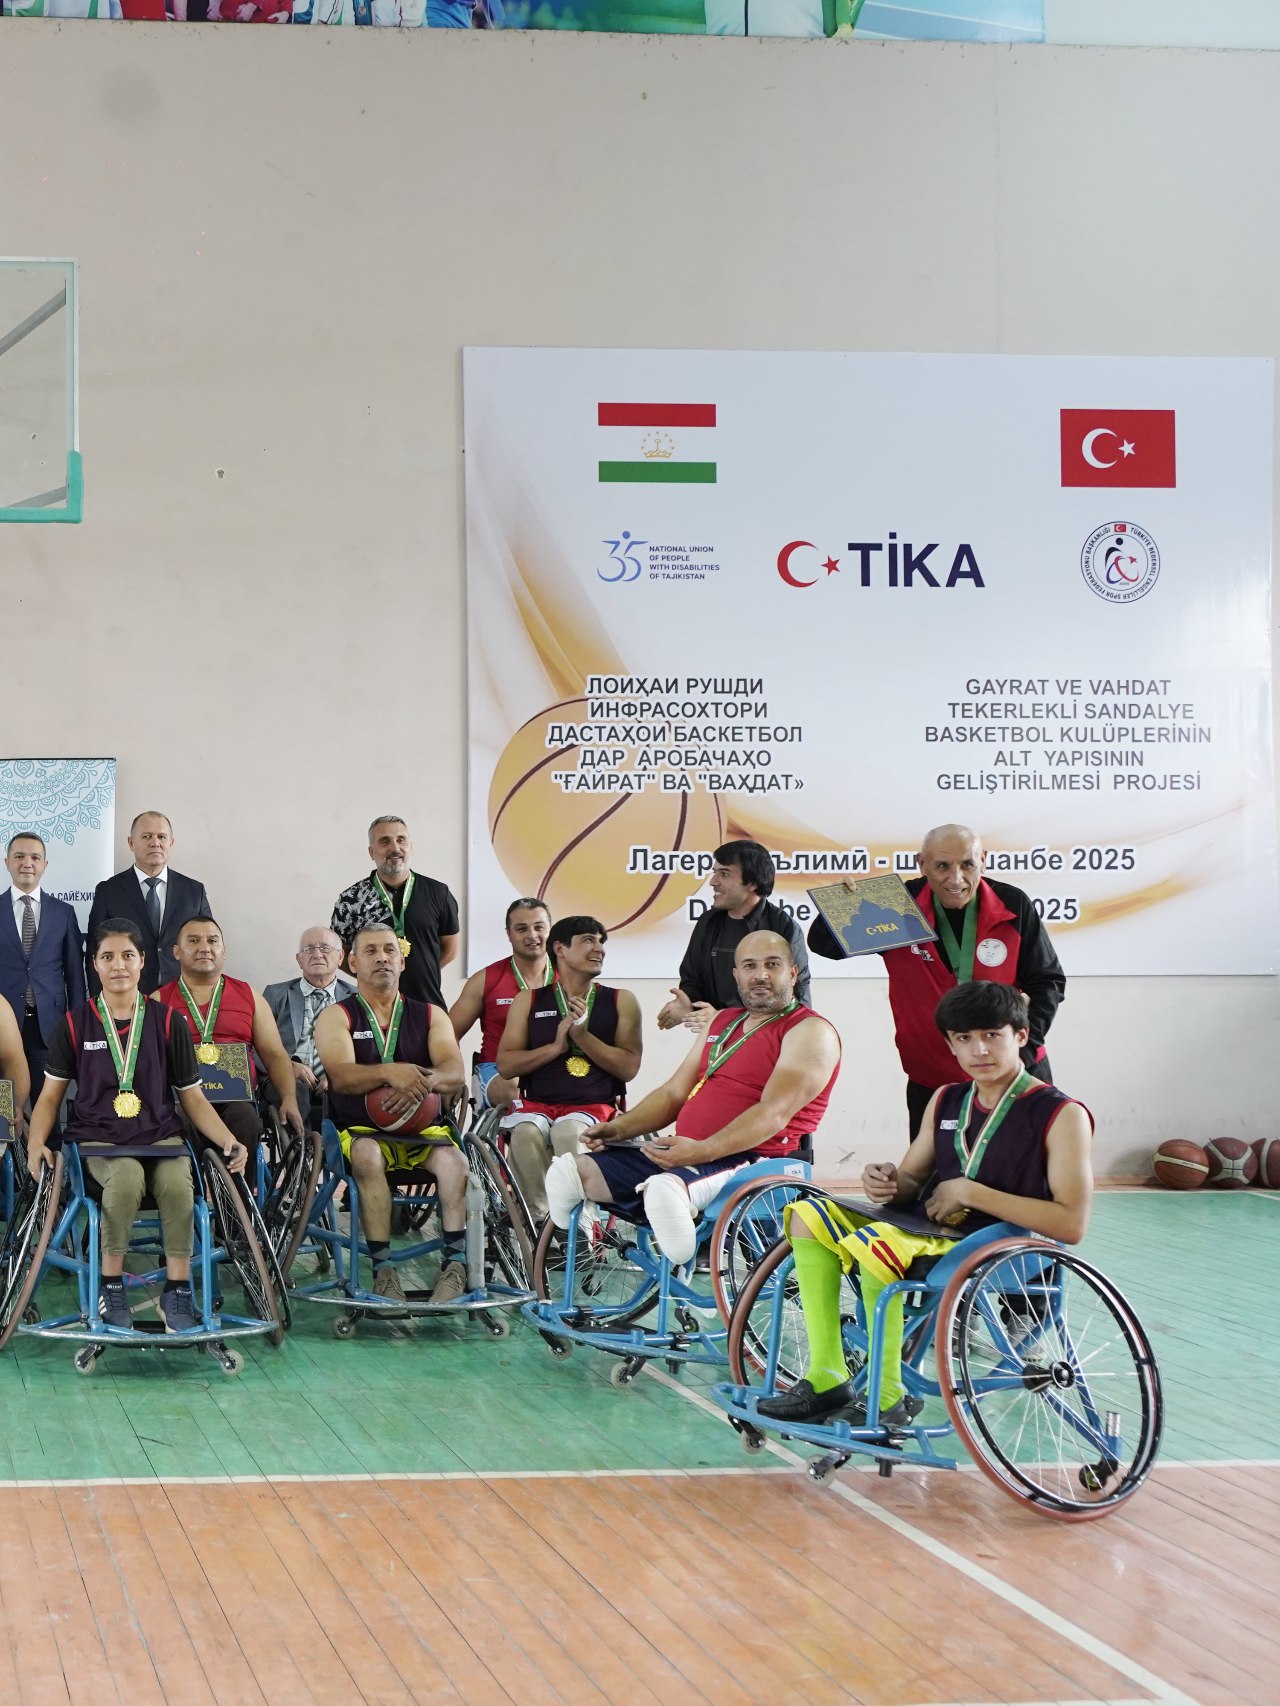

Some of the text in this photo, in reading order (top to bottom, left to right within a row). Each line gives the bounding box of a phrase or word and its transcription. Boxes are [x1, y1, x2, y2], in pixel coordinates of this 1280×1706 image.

[1130, 527, 1151, 547] TÜRKİYE
[649, 545, 715, 553] NATIONAL UNION
[847, 531, 986, 588] TİKA
[588, 678, 764, 697] ЛОИҲАИ РУШДИ
[966, 679, 1171, 695] GAYRAT VE VAHDAT
[590, 701, 768, 719] ИНФРАСОХТОРИ
[948, 699, 1194, 719] TEKERLEKLİ SANDALYE
[548, 725, 802, 745] ДАСТАҲОИ БАСКЕТБОЛ
[925, 723, 1211, 743] BASKETBOL KULÜPLERİNİN
[581, 750, 772, 769] ДАР АРОБАЧАҲО
[993, 750, 1144, 766] ALT YAPISININ
[663, 774, 692, 790] ВА
[936, 770, 1202, 794] GELİŞTİRİLMESİ PROJESİ
[1072, 848, 1135, 870] 2025
[1032, 898, 1077, 920] 025
[876, 923, 900, 933] TİKA
[203, 1080, 224, 1090] TİKA
